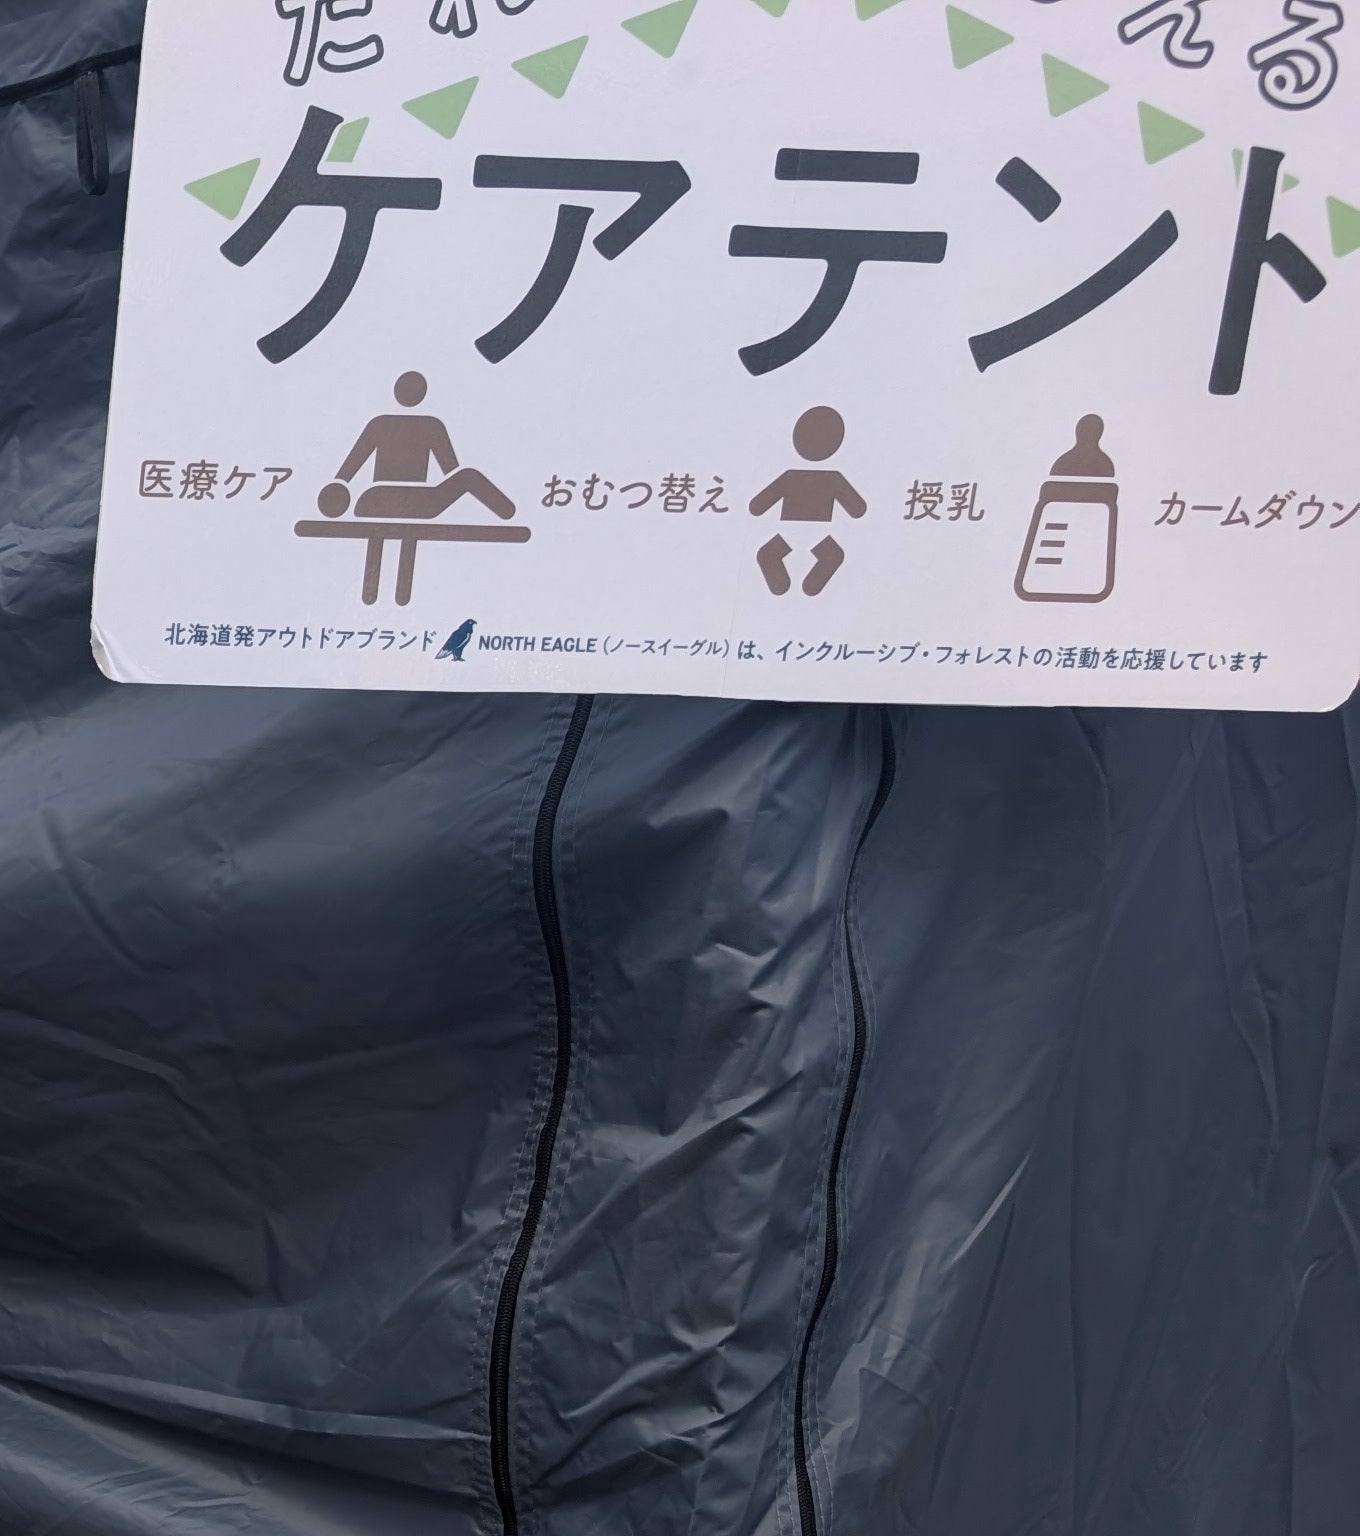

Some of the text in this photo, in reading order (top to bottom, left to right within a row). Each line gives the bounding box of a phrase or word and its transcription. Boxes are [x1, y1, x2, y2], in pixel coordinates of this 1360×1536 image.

[219, 105, 1328, 397] ケアテント
[138, 459, 293, 501] 医療ケア
[541, 472, 729, 514] おむつ替え
[903, 479, 985, 522] 授乳
[1154, 489, 1360, 530] カームダウン
[164, 622, 437, 653] 北海道発アウトドアブランド
[478, 635, 536, 652] NORTH
[541, 636, 598, 653] EAGLE
